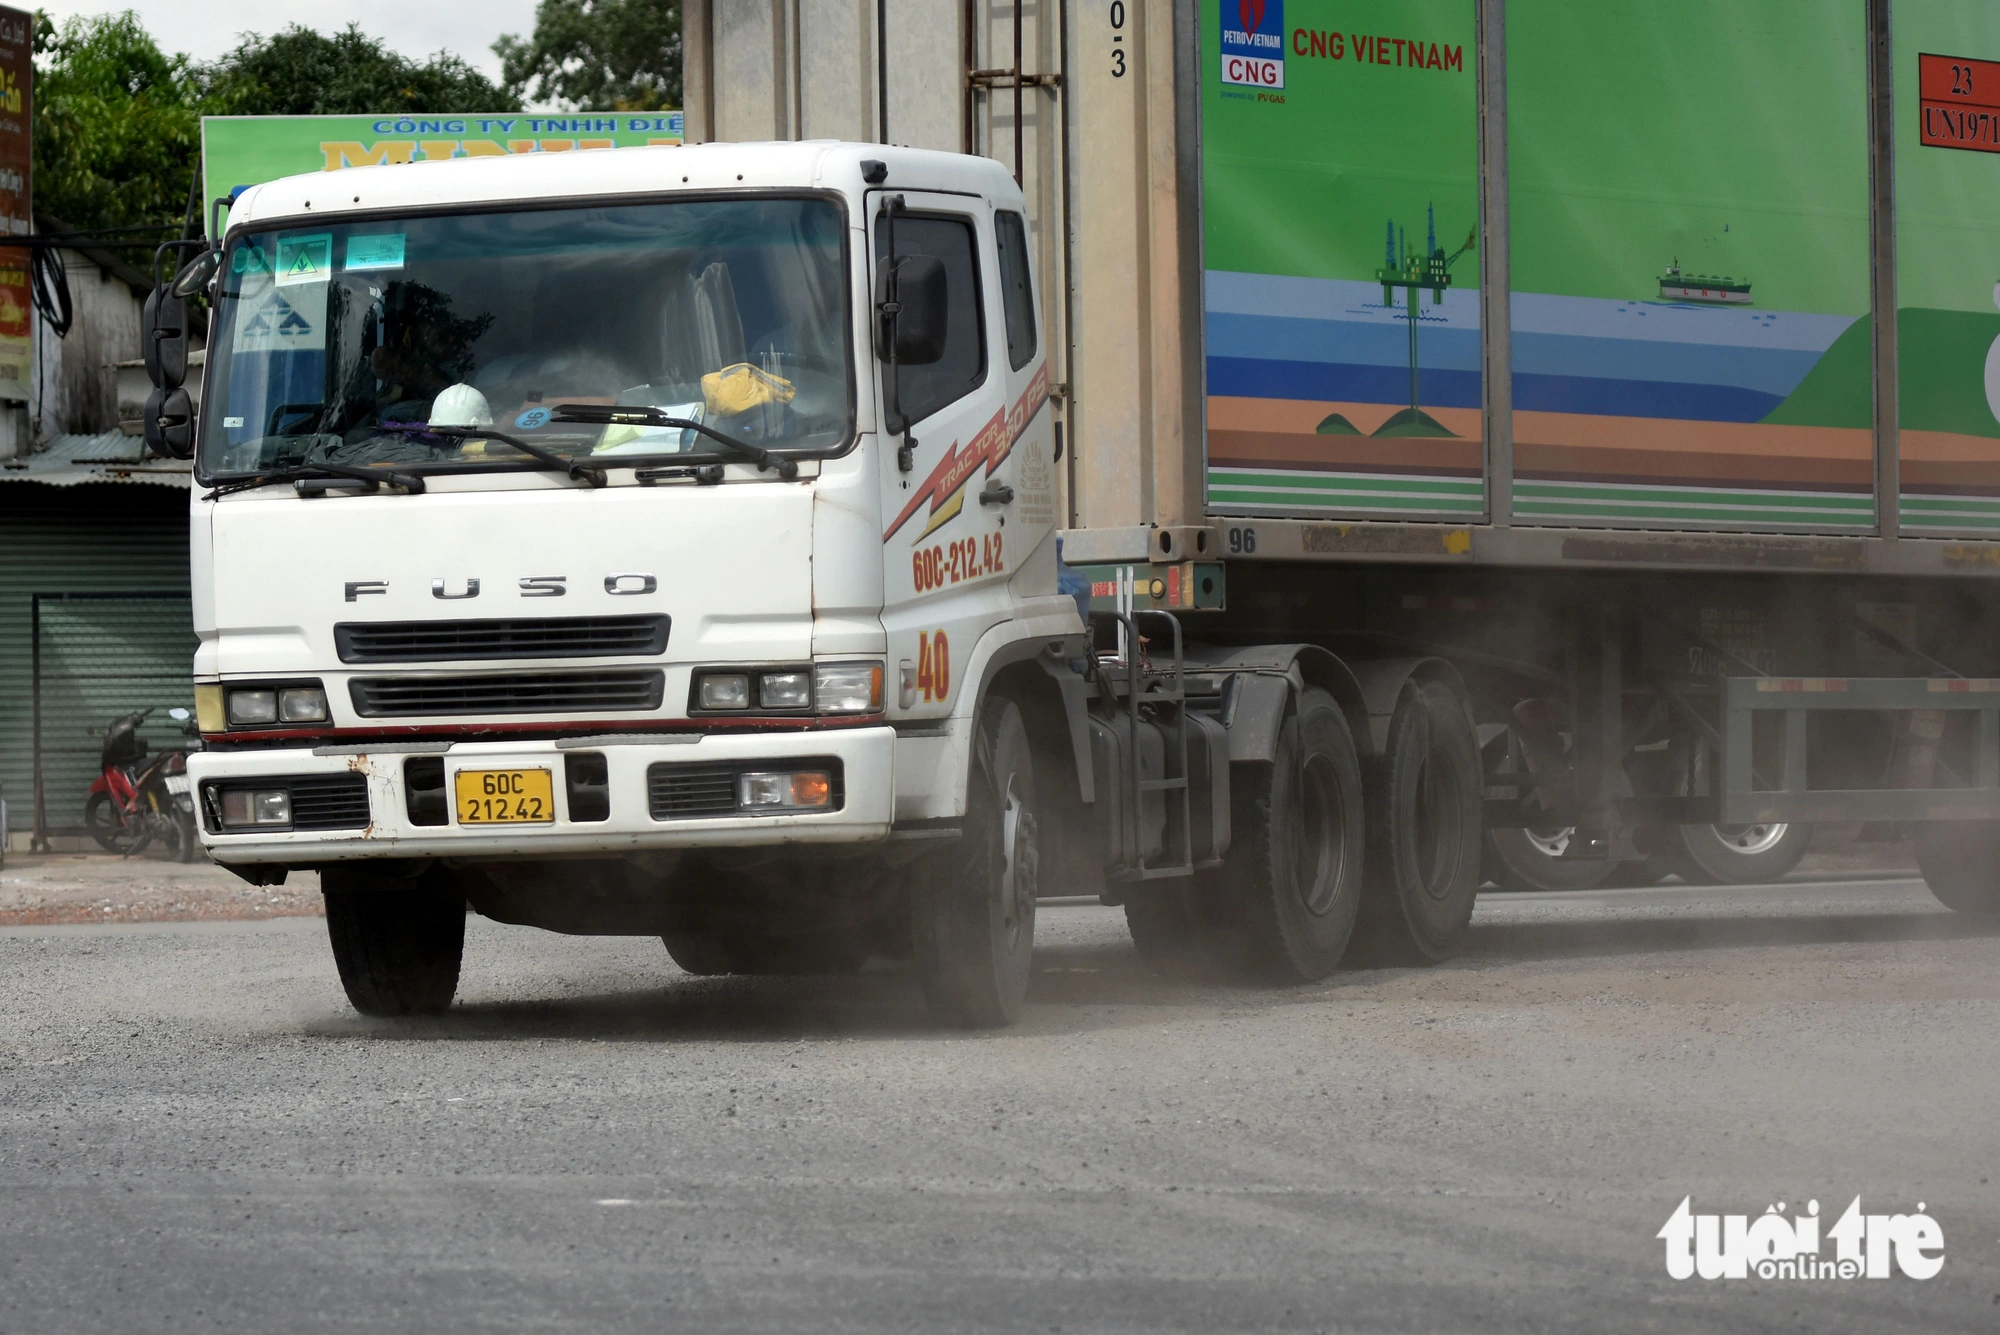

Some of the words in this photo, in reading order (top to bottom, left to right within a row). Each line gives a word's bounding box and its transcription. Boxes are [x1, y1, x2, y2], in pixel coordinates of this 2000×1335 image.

[1223, 29, 1281, 49] PETROVIETNAM
[1293, 28, 1345, 60] CNG
[1351, 34, 1462, 72] VIETNAM
[1229, 59, 1277, 85] CNG
[1951, 64, 1973, 95] 23
[1220, 91, 1246, 100] powered
[1257, 93, 1269, 102] PV
[1269, 94, 1286, 104] GAS
[372, 116, 466, 134] CÔNG
[475, 118, 519, 133] TY
[525, 118, 617, 132] TNHH
[1925, 107, 2000, 144] UN1971
[1683, 287, 1727, 298] LNG
[1027, 371, 1046, 414] PS
[1229, 527, 1256, 554] 96
[912, 530, 1004, 593] 60C-212.42
[344, 572, 657, 602] FUSO
[916, 627, 950, 703] 40
[483, 773, 524, 795] 60C
[468, 797, 543, 820] 212.42
